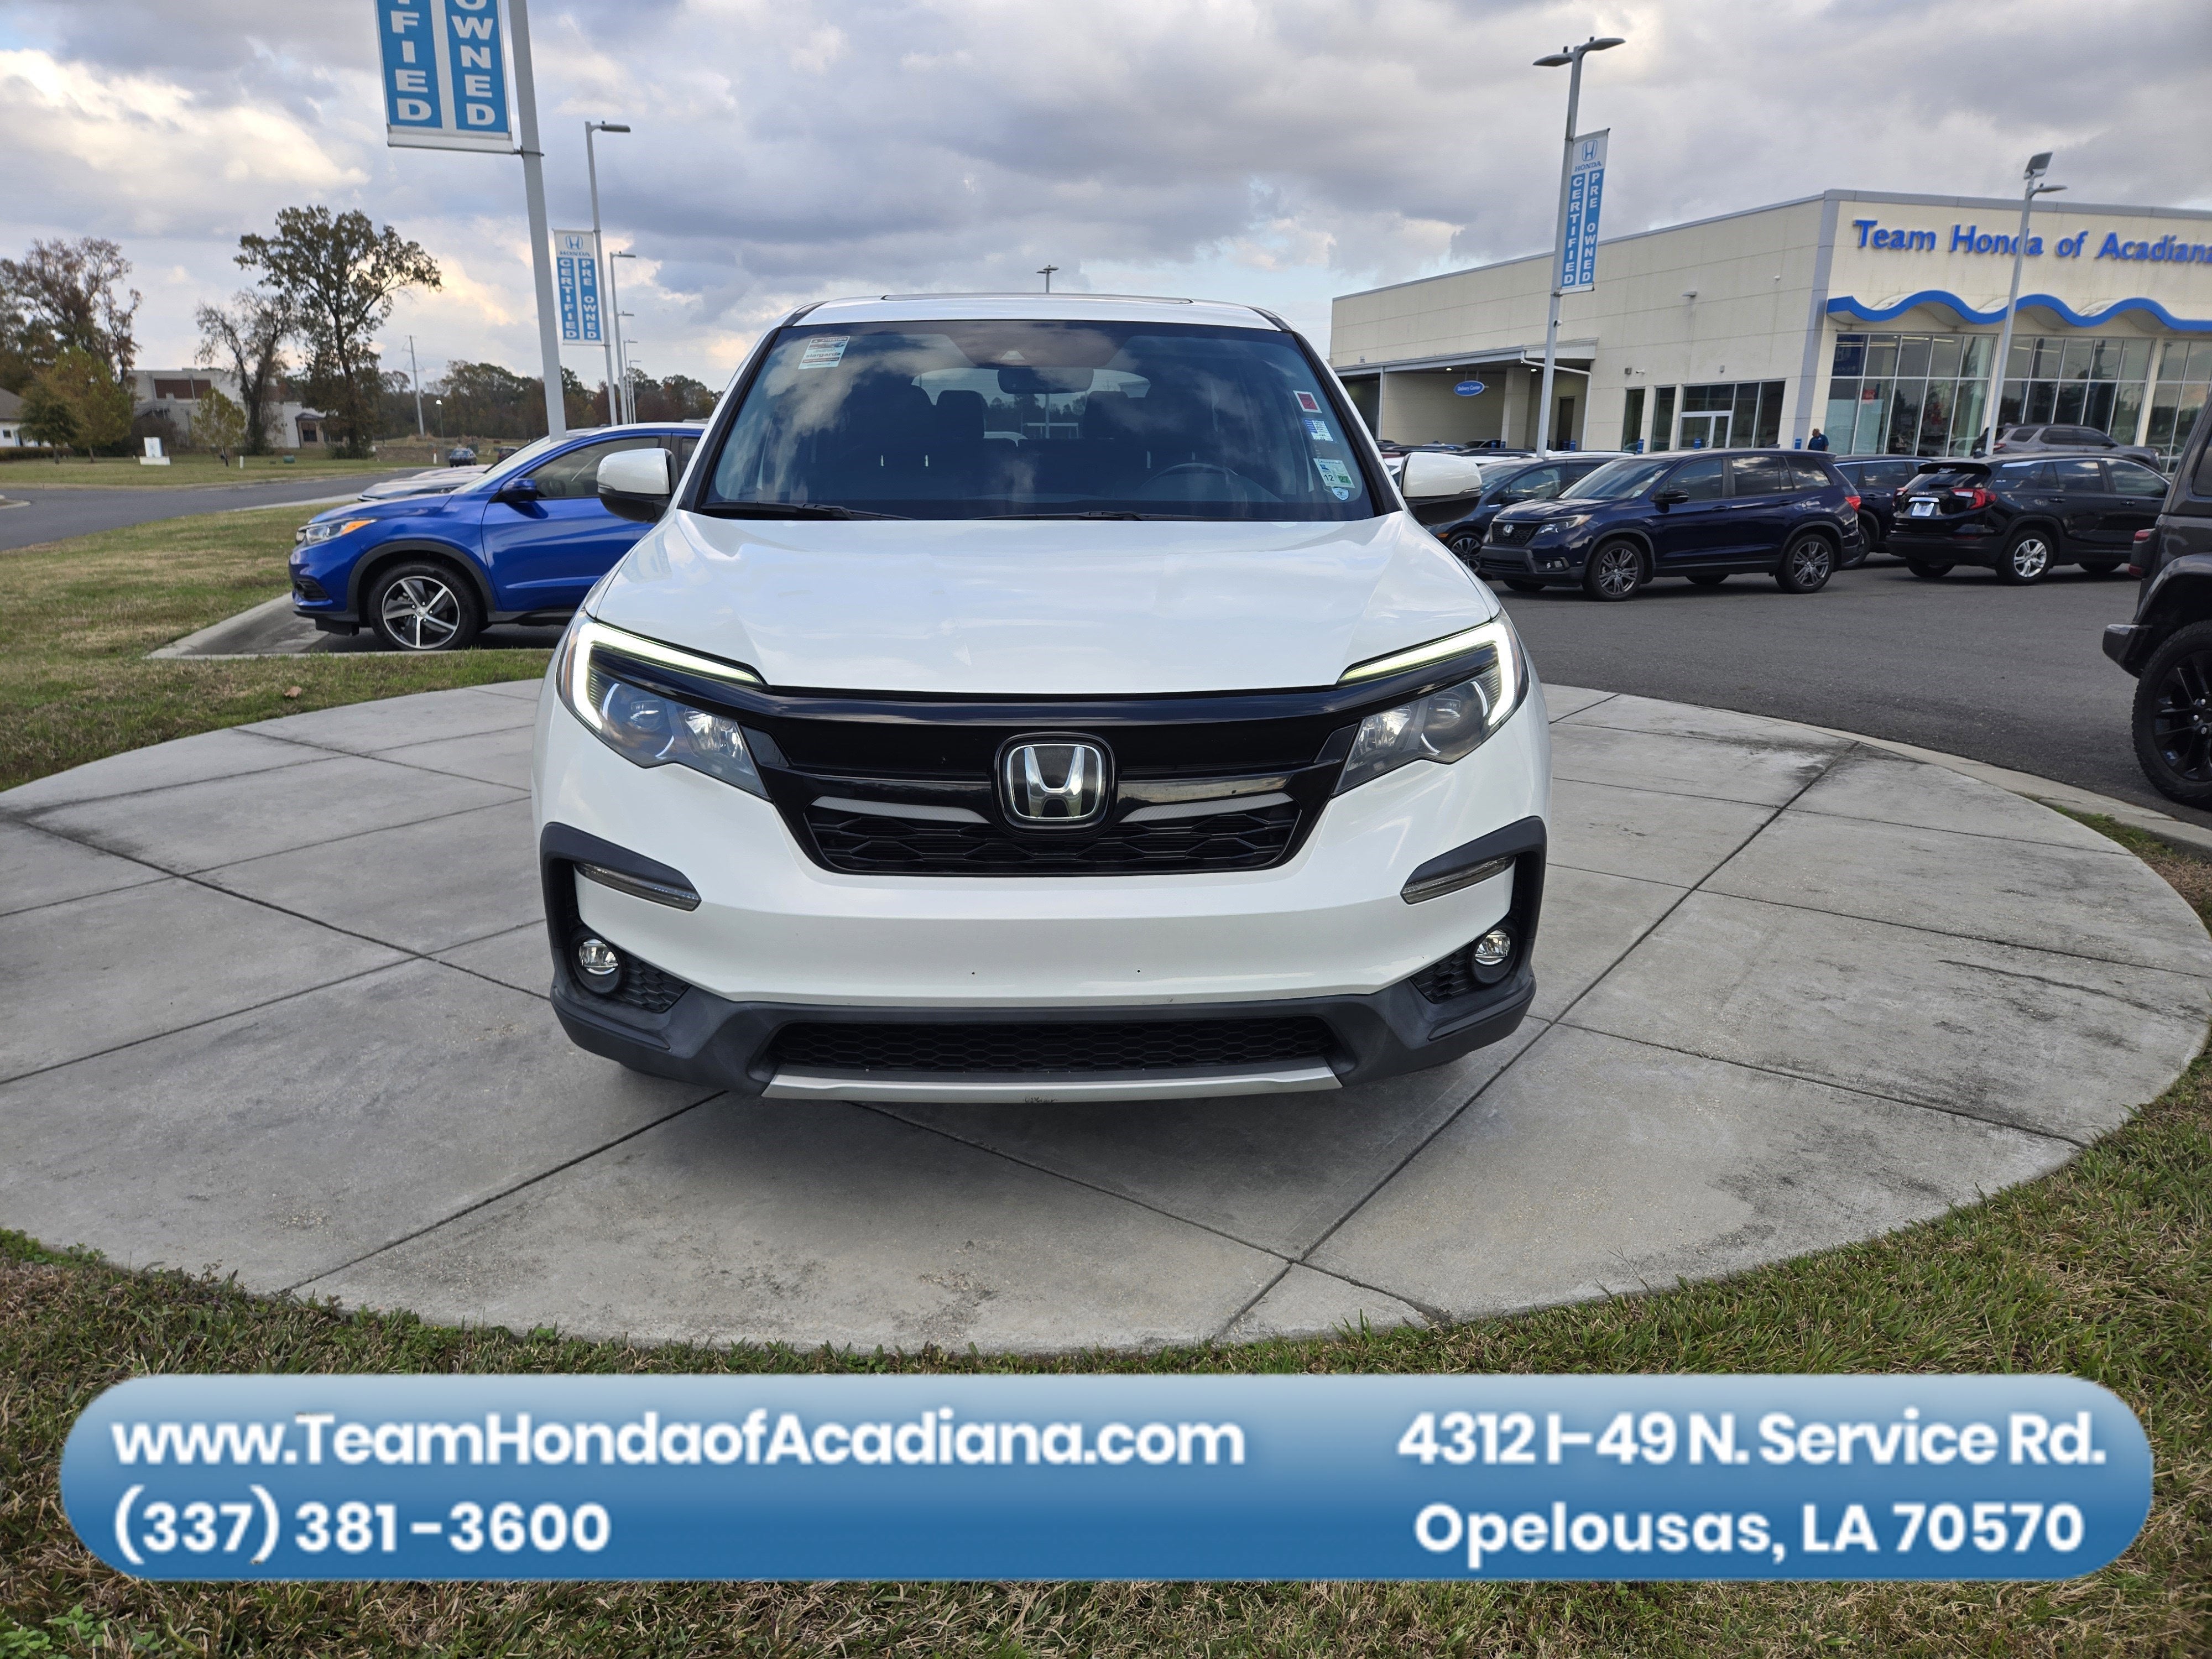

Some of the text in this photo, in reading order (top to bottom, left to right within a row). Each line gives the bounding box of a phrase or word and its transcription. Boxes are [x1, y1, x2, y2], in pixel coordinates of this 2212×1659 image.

[1574, 160, 1601, 173] HONDA
[1563, 176, 1583, 285] CERTIFIED
[1582, 172, 1600, 283] PRE OWNED
[1854, 219, 1937, 250] Team
[2057, 230, 2089, 257] of
[559, 259, 578, 338] CERTIFIED
[581, 259, 597, 340] PRE OWNED
